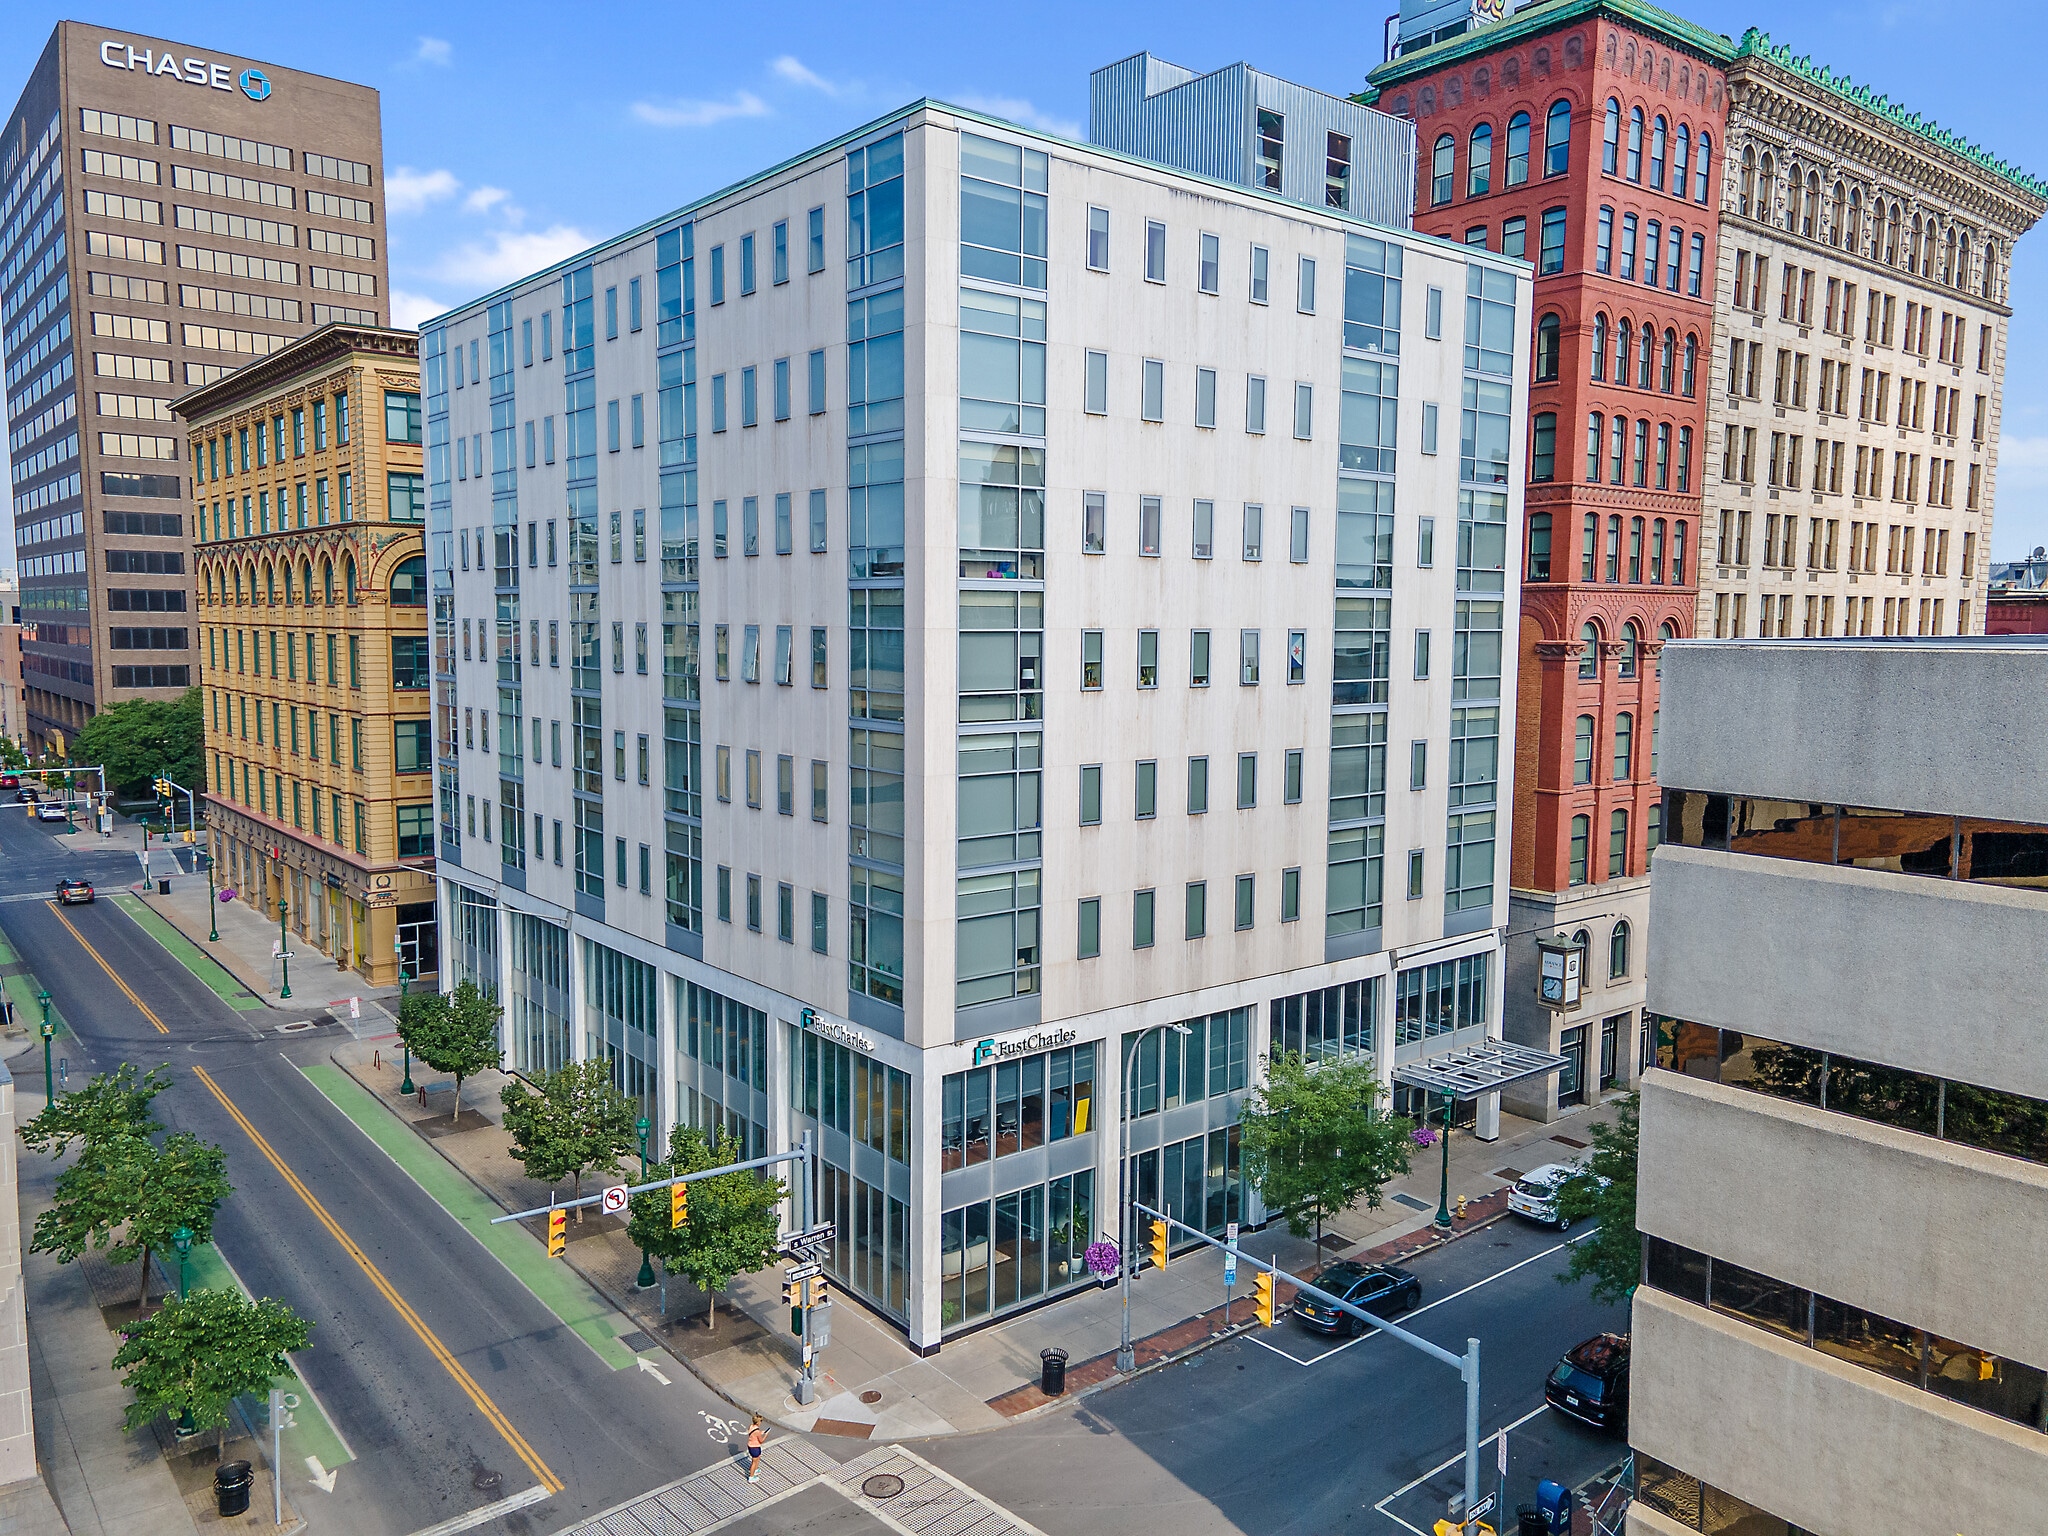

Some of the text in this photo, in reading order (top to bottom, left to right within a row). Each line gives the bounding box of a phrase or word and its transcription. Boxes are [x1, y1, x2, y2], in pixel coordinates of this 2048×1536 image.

[100, 40, 233, 92] CHASE
[814, 1017, 869, 1052] FustCharles
[998, 1028, 1076, 1057] FustCharles
[800, 1232, 825, 1246] Warren
